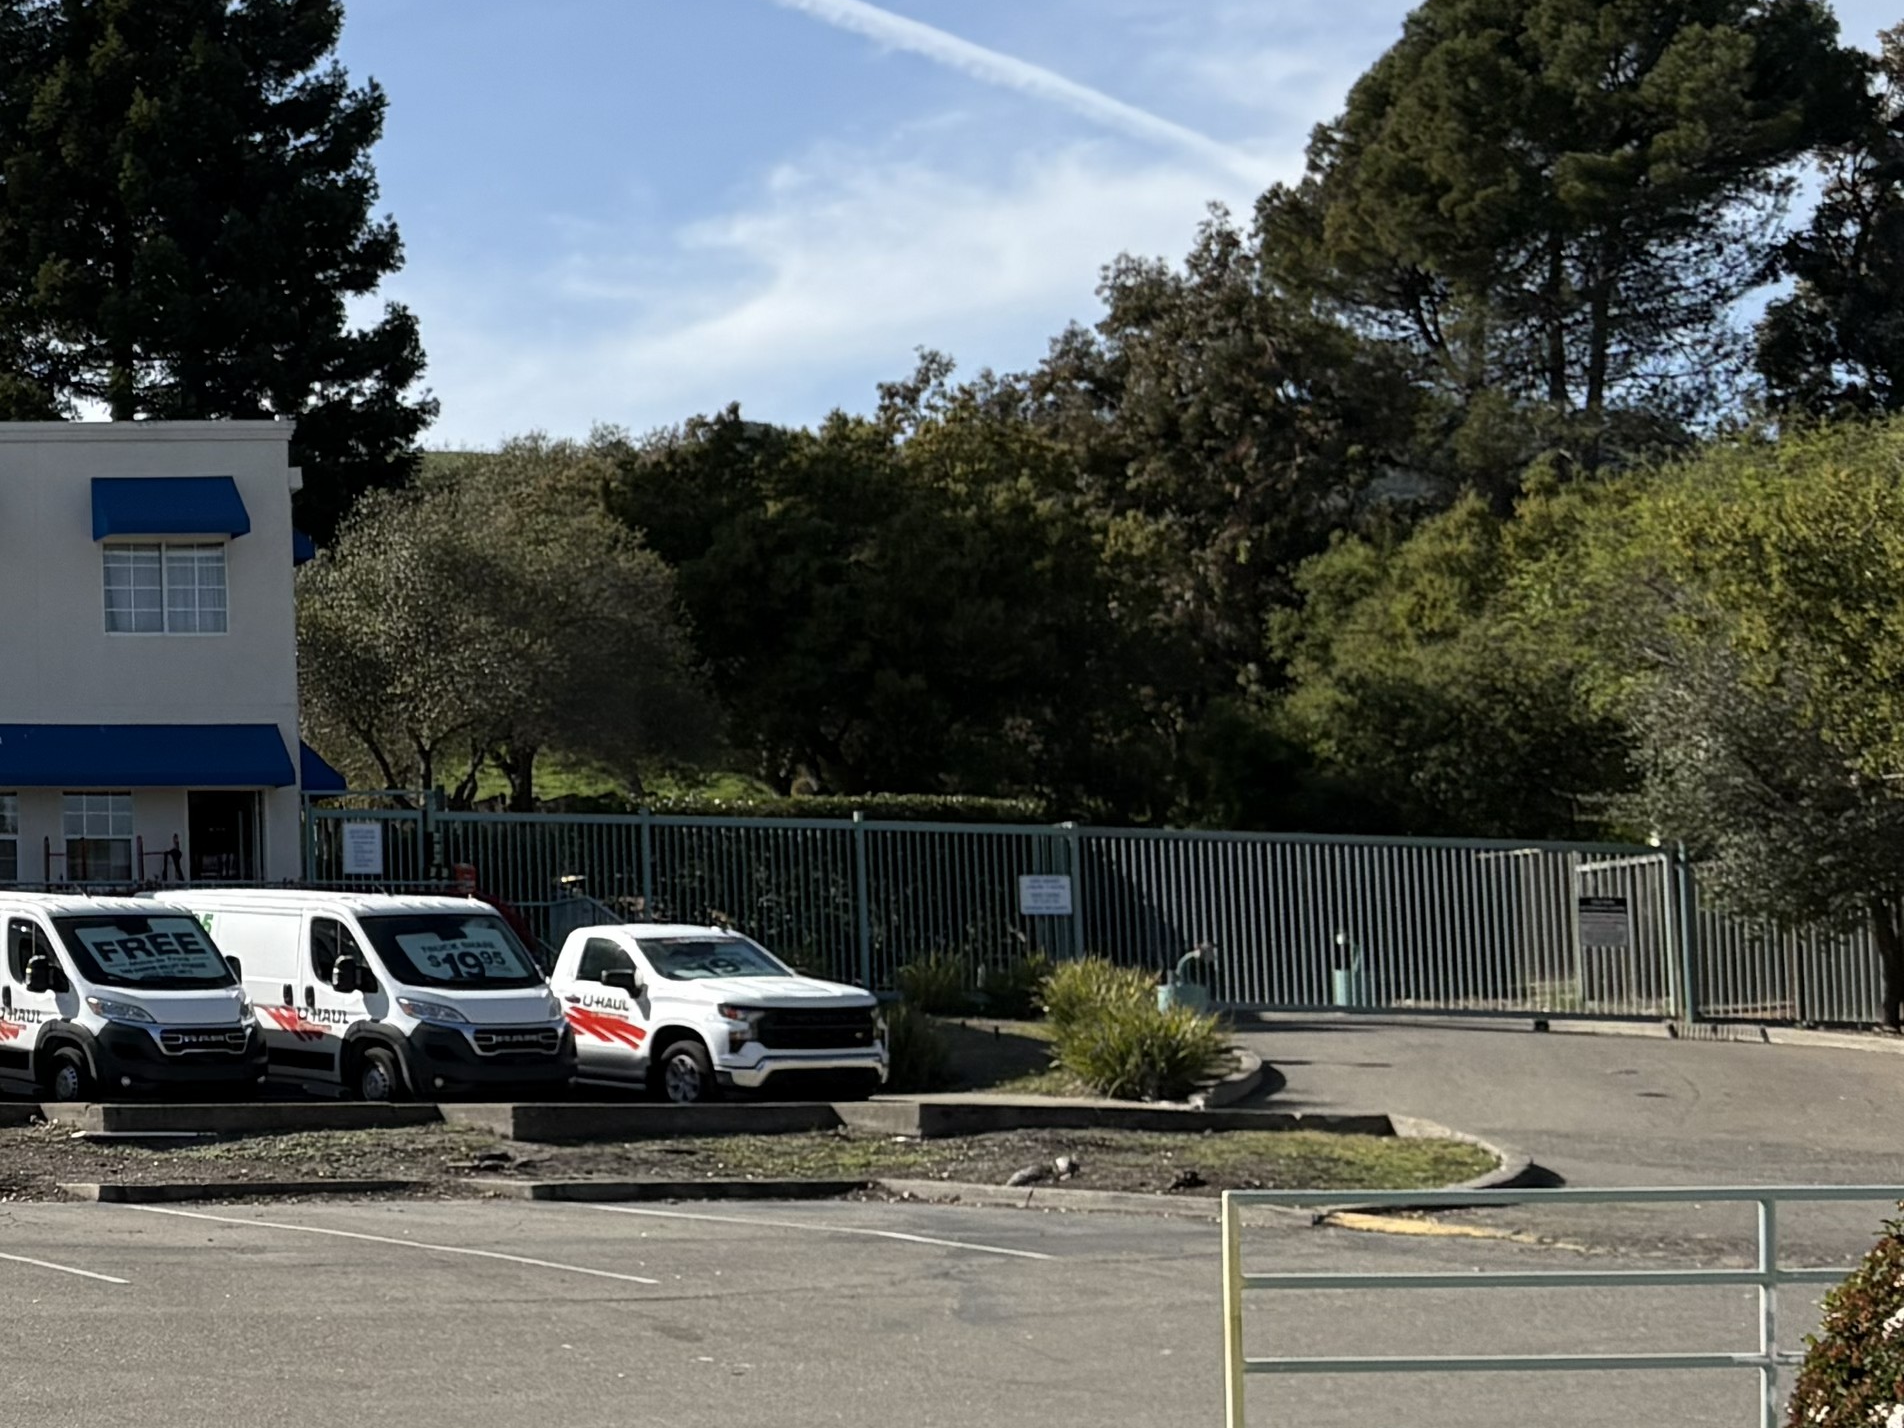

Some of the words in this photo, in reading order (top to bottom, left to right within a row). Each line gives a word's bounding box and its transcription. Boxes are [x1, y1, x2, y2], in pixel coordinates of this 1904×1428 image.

[92, 932, 207, 964] FREE
[581, 994, 630, 1012] U-HAUL
[181, 1033, 226, 1043] RAM
